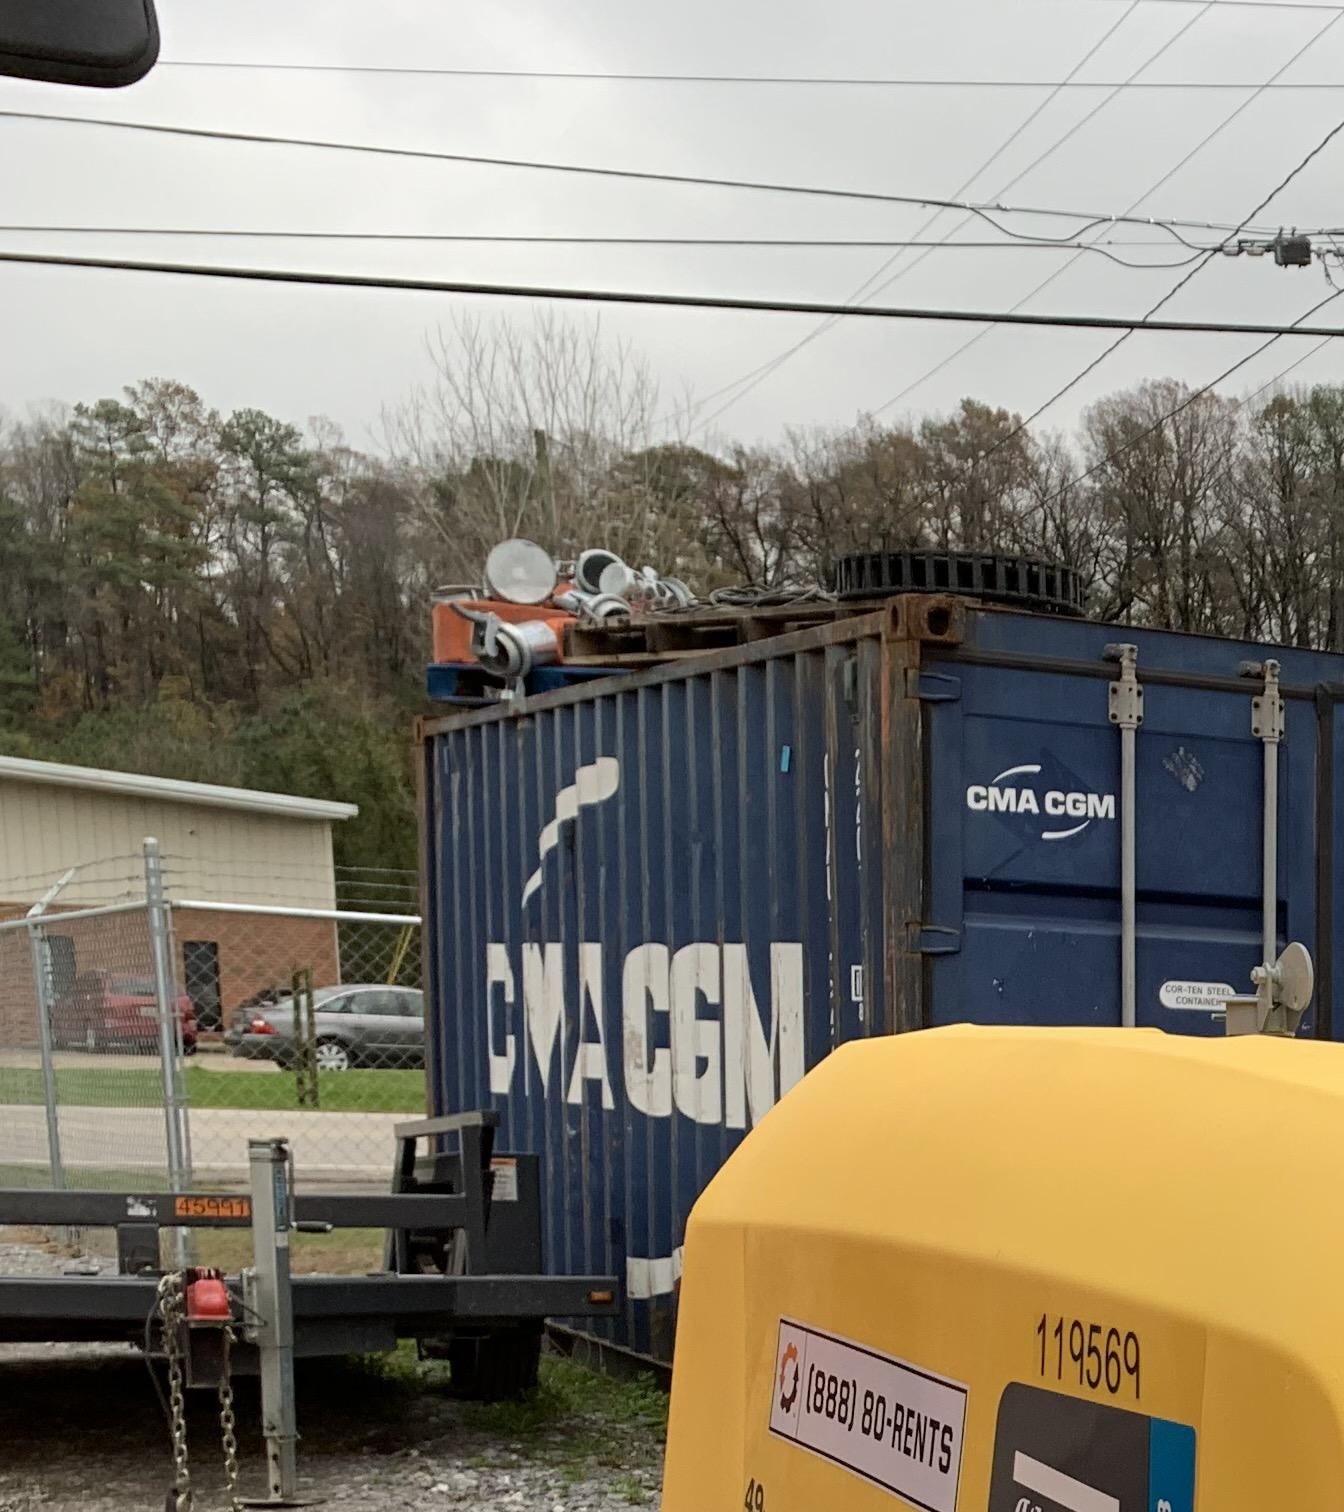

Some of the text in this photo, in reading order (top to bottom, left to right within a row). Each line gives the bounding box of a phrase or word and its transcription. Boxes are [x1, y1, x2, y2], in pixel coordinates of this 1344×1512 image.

[967, 784, 1116, 820] CMA CGM
[1165, 984, 1232, 996] COR-TEN STEEL
[486, 942, 616, 1111] CMA
[621, 941, 806, 1130] CGM
[1036, 1312, 1141, 1400] 119569
[806, 1362, 954, 1475] (888) 80-RENTS
